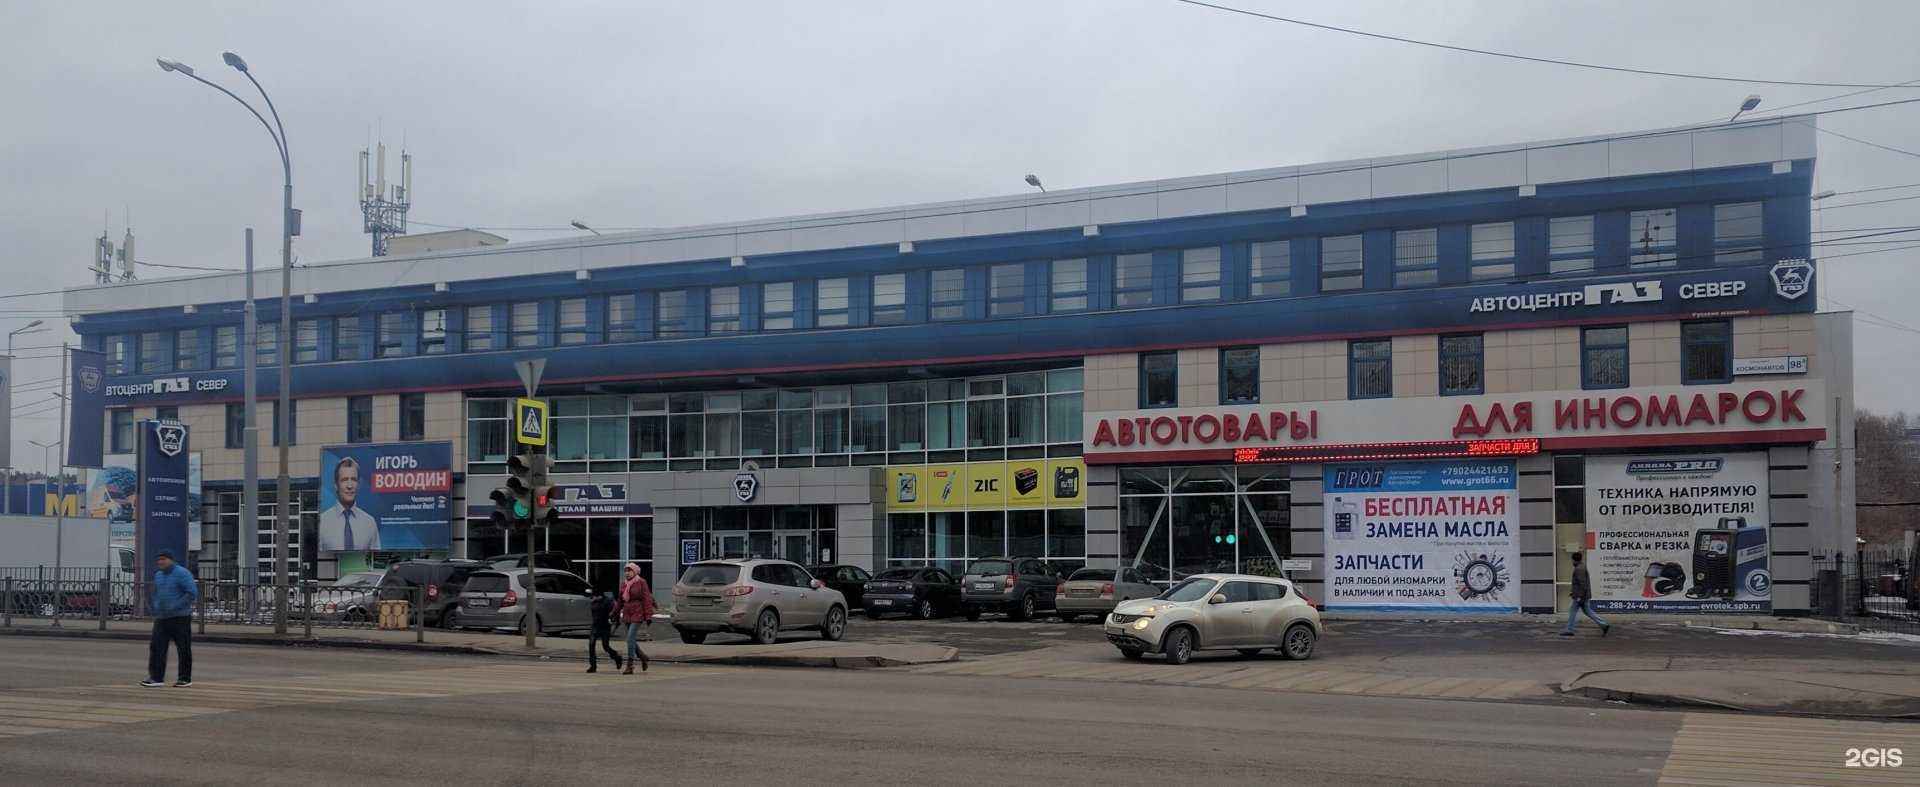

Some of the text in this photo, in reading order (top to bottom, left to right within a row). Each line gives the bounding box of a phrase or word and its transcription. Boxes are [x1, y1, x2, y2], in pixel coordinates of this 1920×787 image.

[1470, 280, 1746, 312] АВТОЦЕНТР ГАЗ СЕВЕР
[104, 377, 228, 397] ВТОЦЕНТР ГАЗ СЕВЕР
[1092, 389, 1807, 446] АВТОТОВАРЫ ДЛЯ ИНОМАРОК
[1468, 442, 1511, 452] ЗАПЧАСТИ
[375, 455, 418, 469] ИГОРЬ
[375, 471, 447, 490] ВОЛОДИН
[974, 478, 998, 493] ZIC
[1335, 471, 1384, 486] ГРОТ
[1441, 476, 1509, 487] www.grot66.ru
[1598, 485, 1757, 499] ТЕХНИКА НАПРЯМУЮ
[555, 505, 624, 513] ЕТАЛИ МАШИН
[1364, 495, 1506, 517] БЕСПЛАТНАЯ
[1598, 502, 1755, 516] ОТ ПРОИЗВОДИТЕЛЯ!
[1366, 521, 1509, 538] ЗАМЕНА МАСЛА
[1599, 530, 1690, 538] ПРОФЕССИОНАЛЬНАЯ
[1599, 541, 1642, 551] СВАРКА
[1655, 541, 1690, 551] РЕЗКА
[1334, 554, 1424, 570] ЗАПЧАСТИ
[1334, 575, 1446, 585] ДЛЯ ЛЮБОЙ ИНОМАРКИ
[1334, 589, 1446, 598] В НАЛИЧИИ И ПОД ЗАКАЗ
[1700, 602, 1761, 611] evrotek.spb.ru
